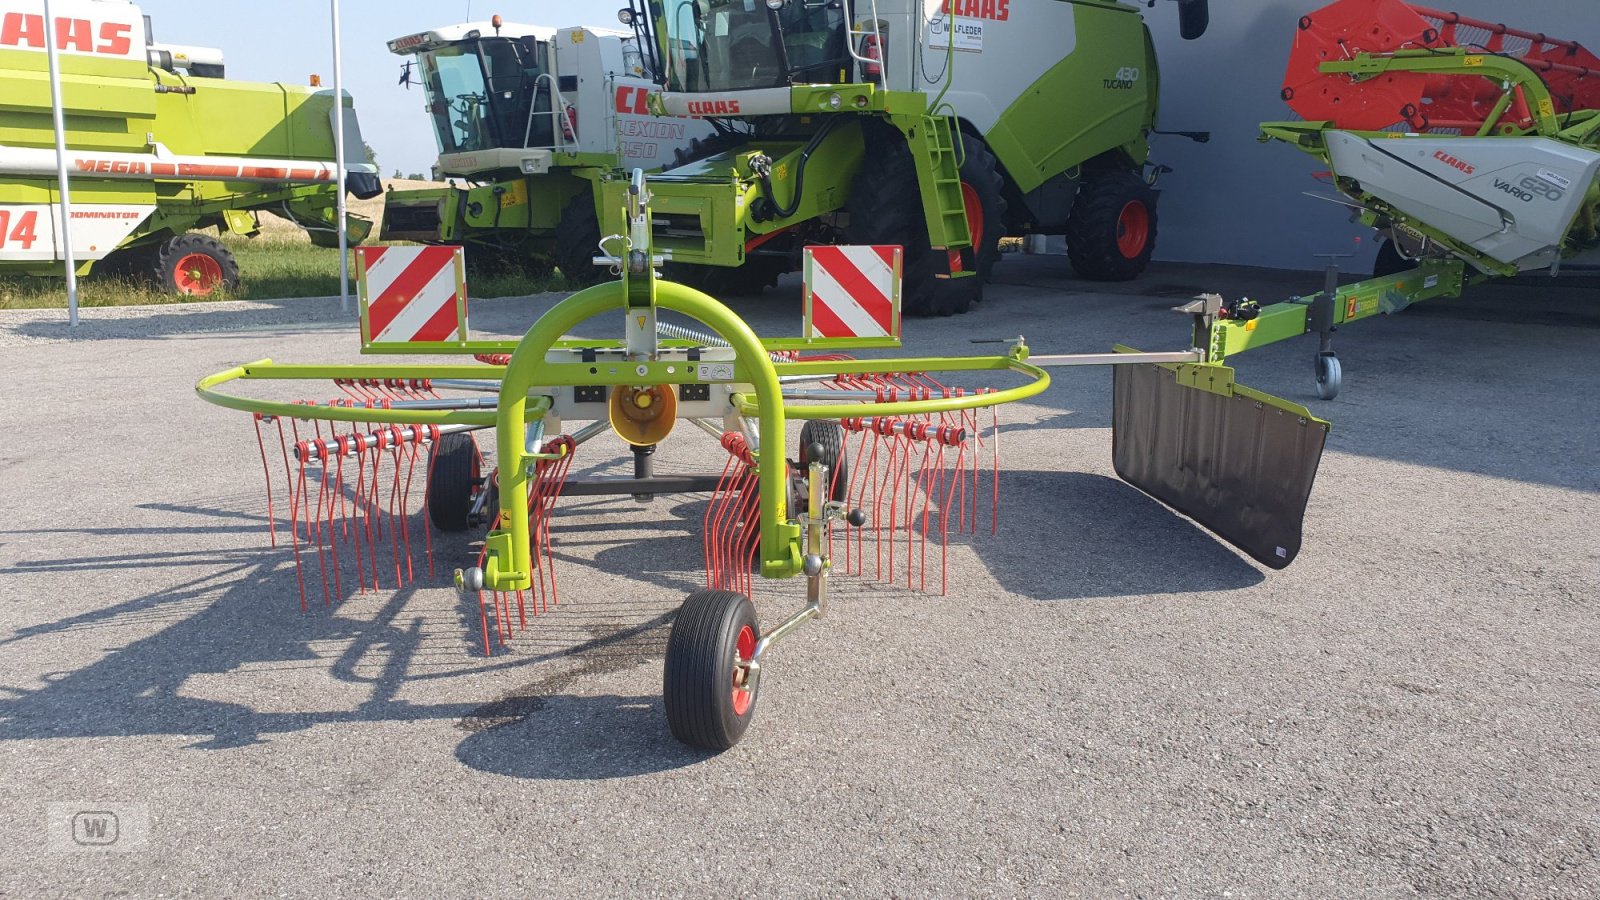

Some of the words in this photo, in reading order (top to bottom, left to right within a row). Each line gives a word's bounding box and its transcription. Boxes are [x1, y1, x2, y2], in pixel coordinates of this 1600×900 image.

[943, 23, 982, 36] WLFLEDER
[1103, 79, 1133, 89] TUCANO
[688, 100, 740, 115] CLAAS
[75, 159, 146, 174] MEGA
[1433, 150, 1475, 175] CLAAS
[1494, 178, 1534, 203] VARIO
